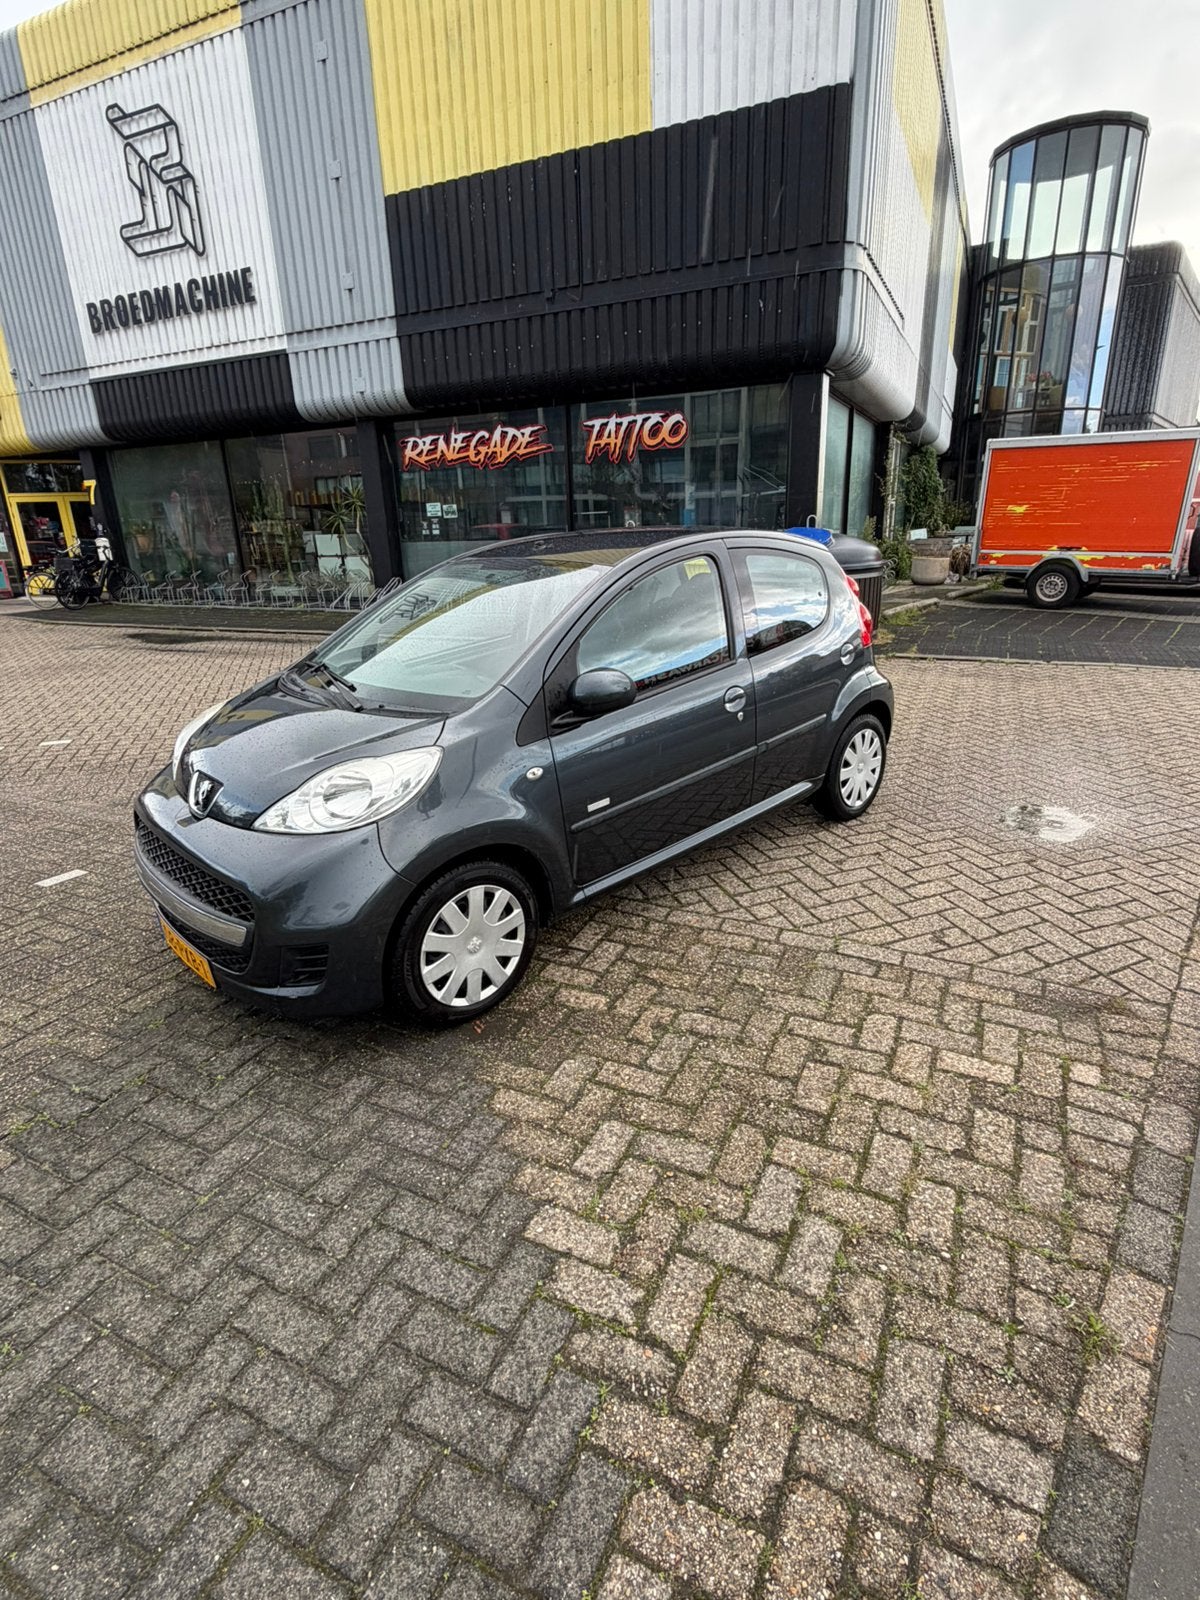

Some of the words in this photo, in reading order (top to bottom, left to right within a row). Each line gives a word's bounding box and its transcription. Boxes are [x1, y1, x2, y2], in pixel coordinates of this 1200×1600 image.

[86, 266, 256, 334] BROEDMACHINE
[401, 422, 553, 471] RENEGADE
[583, 409, 689, 464] TATTOO
[82, 479, 97, 505] 7
